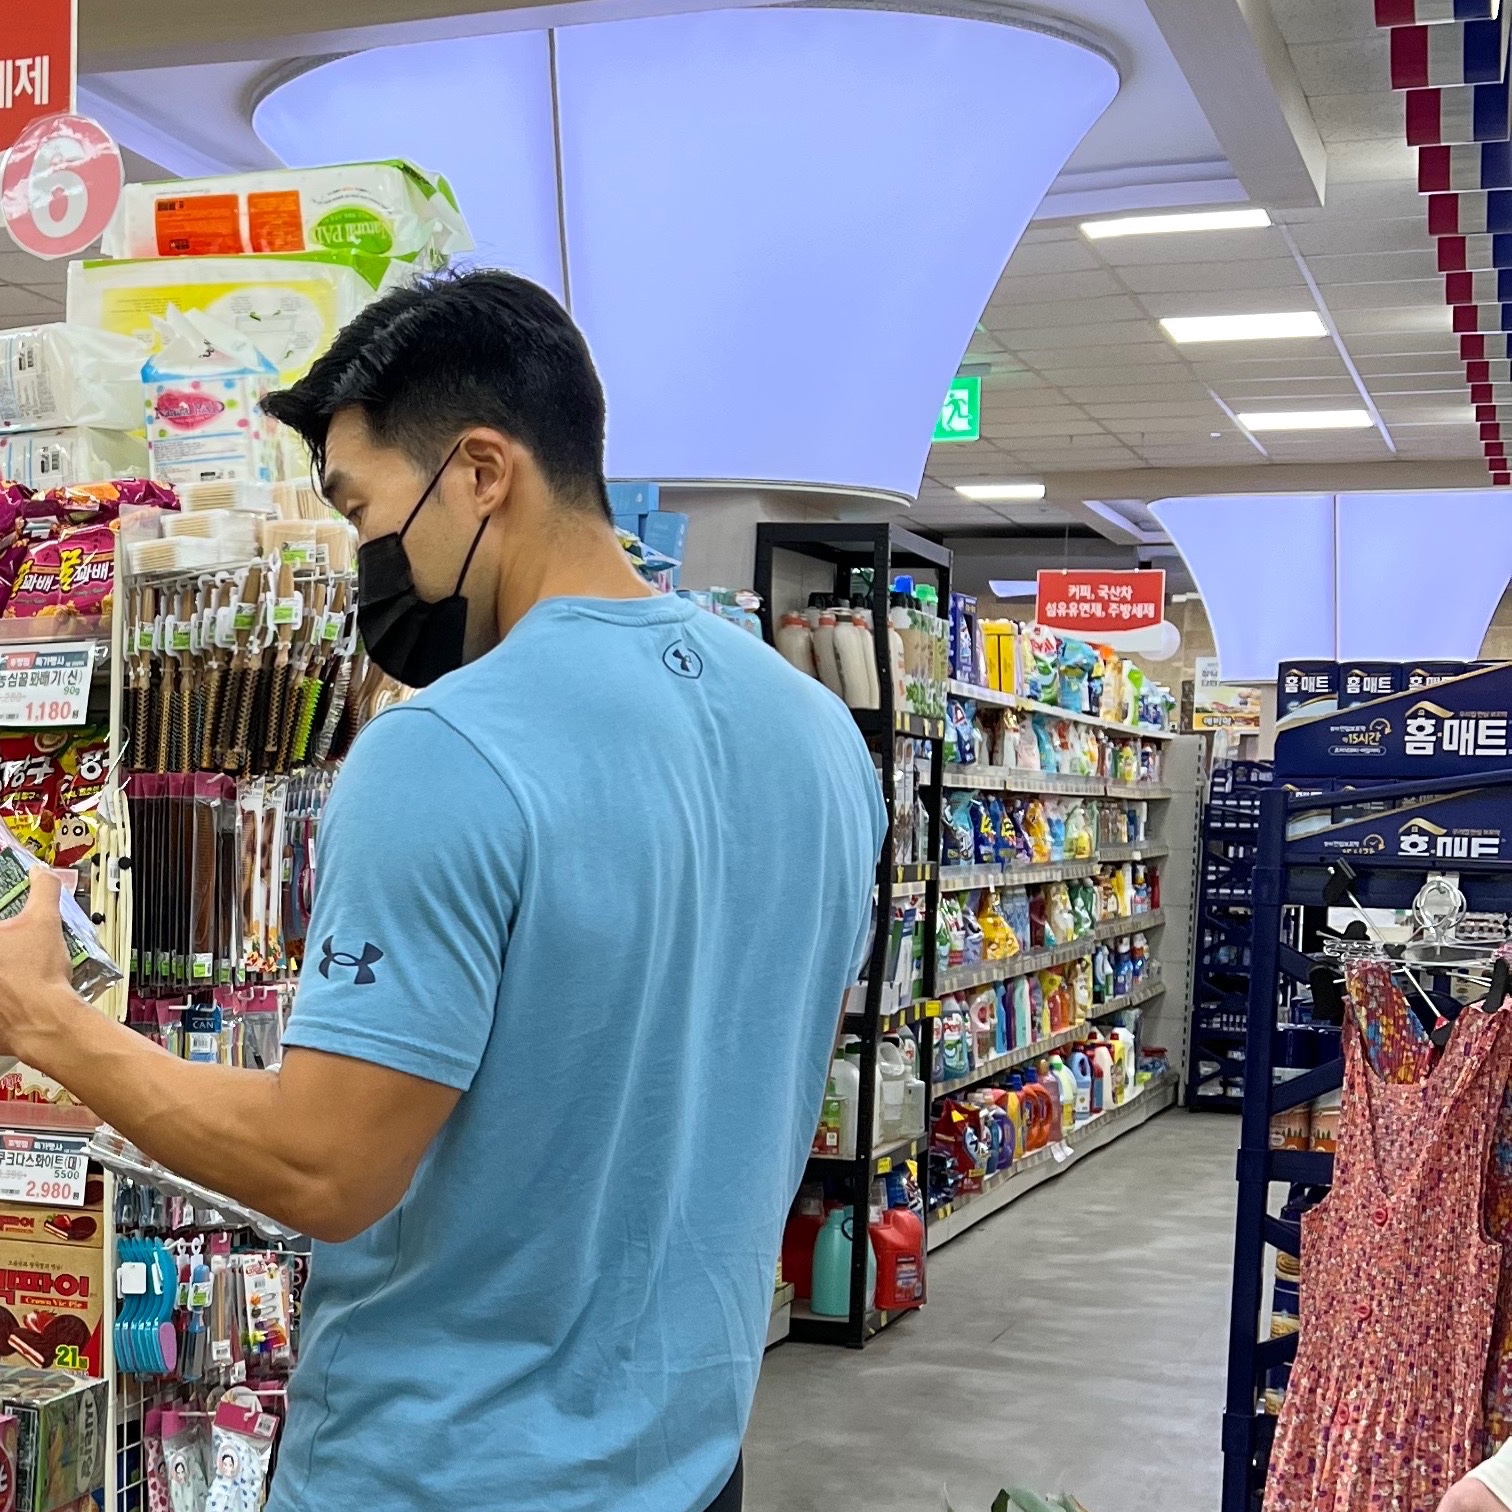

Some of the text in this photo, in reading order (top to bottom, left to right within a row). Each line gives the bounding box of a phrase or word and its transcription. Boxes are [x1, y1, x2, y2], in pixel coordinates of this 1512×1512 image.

[28, 137, 88, 238] 6
[1097, 584, 1134, 601] 국산차
[1107, 601, 1156, 620] 주방세제
[63, 685, 81, 697] 90g
[25, 700, 72, 722] 1,180
[53, 1169, 80, 1180] 5500
[55, 1344, 78, 1369] 21
